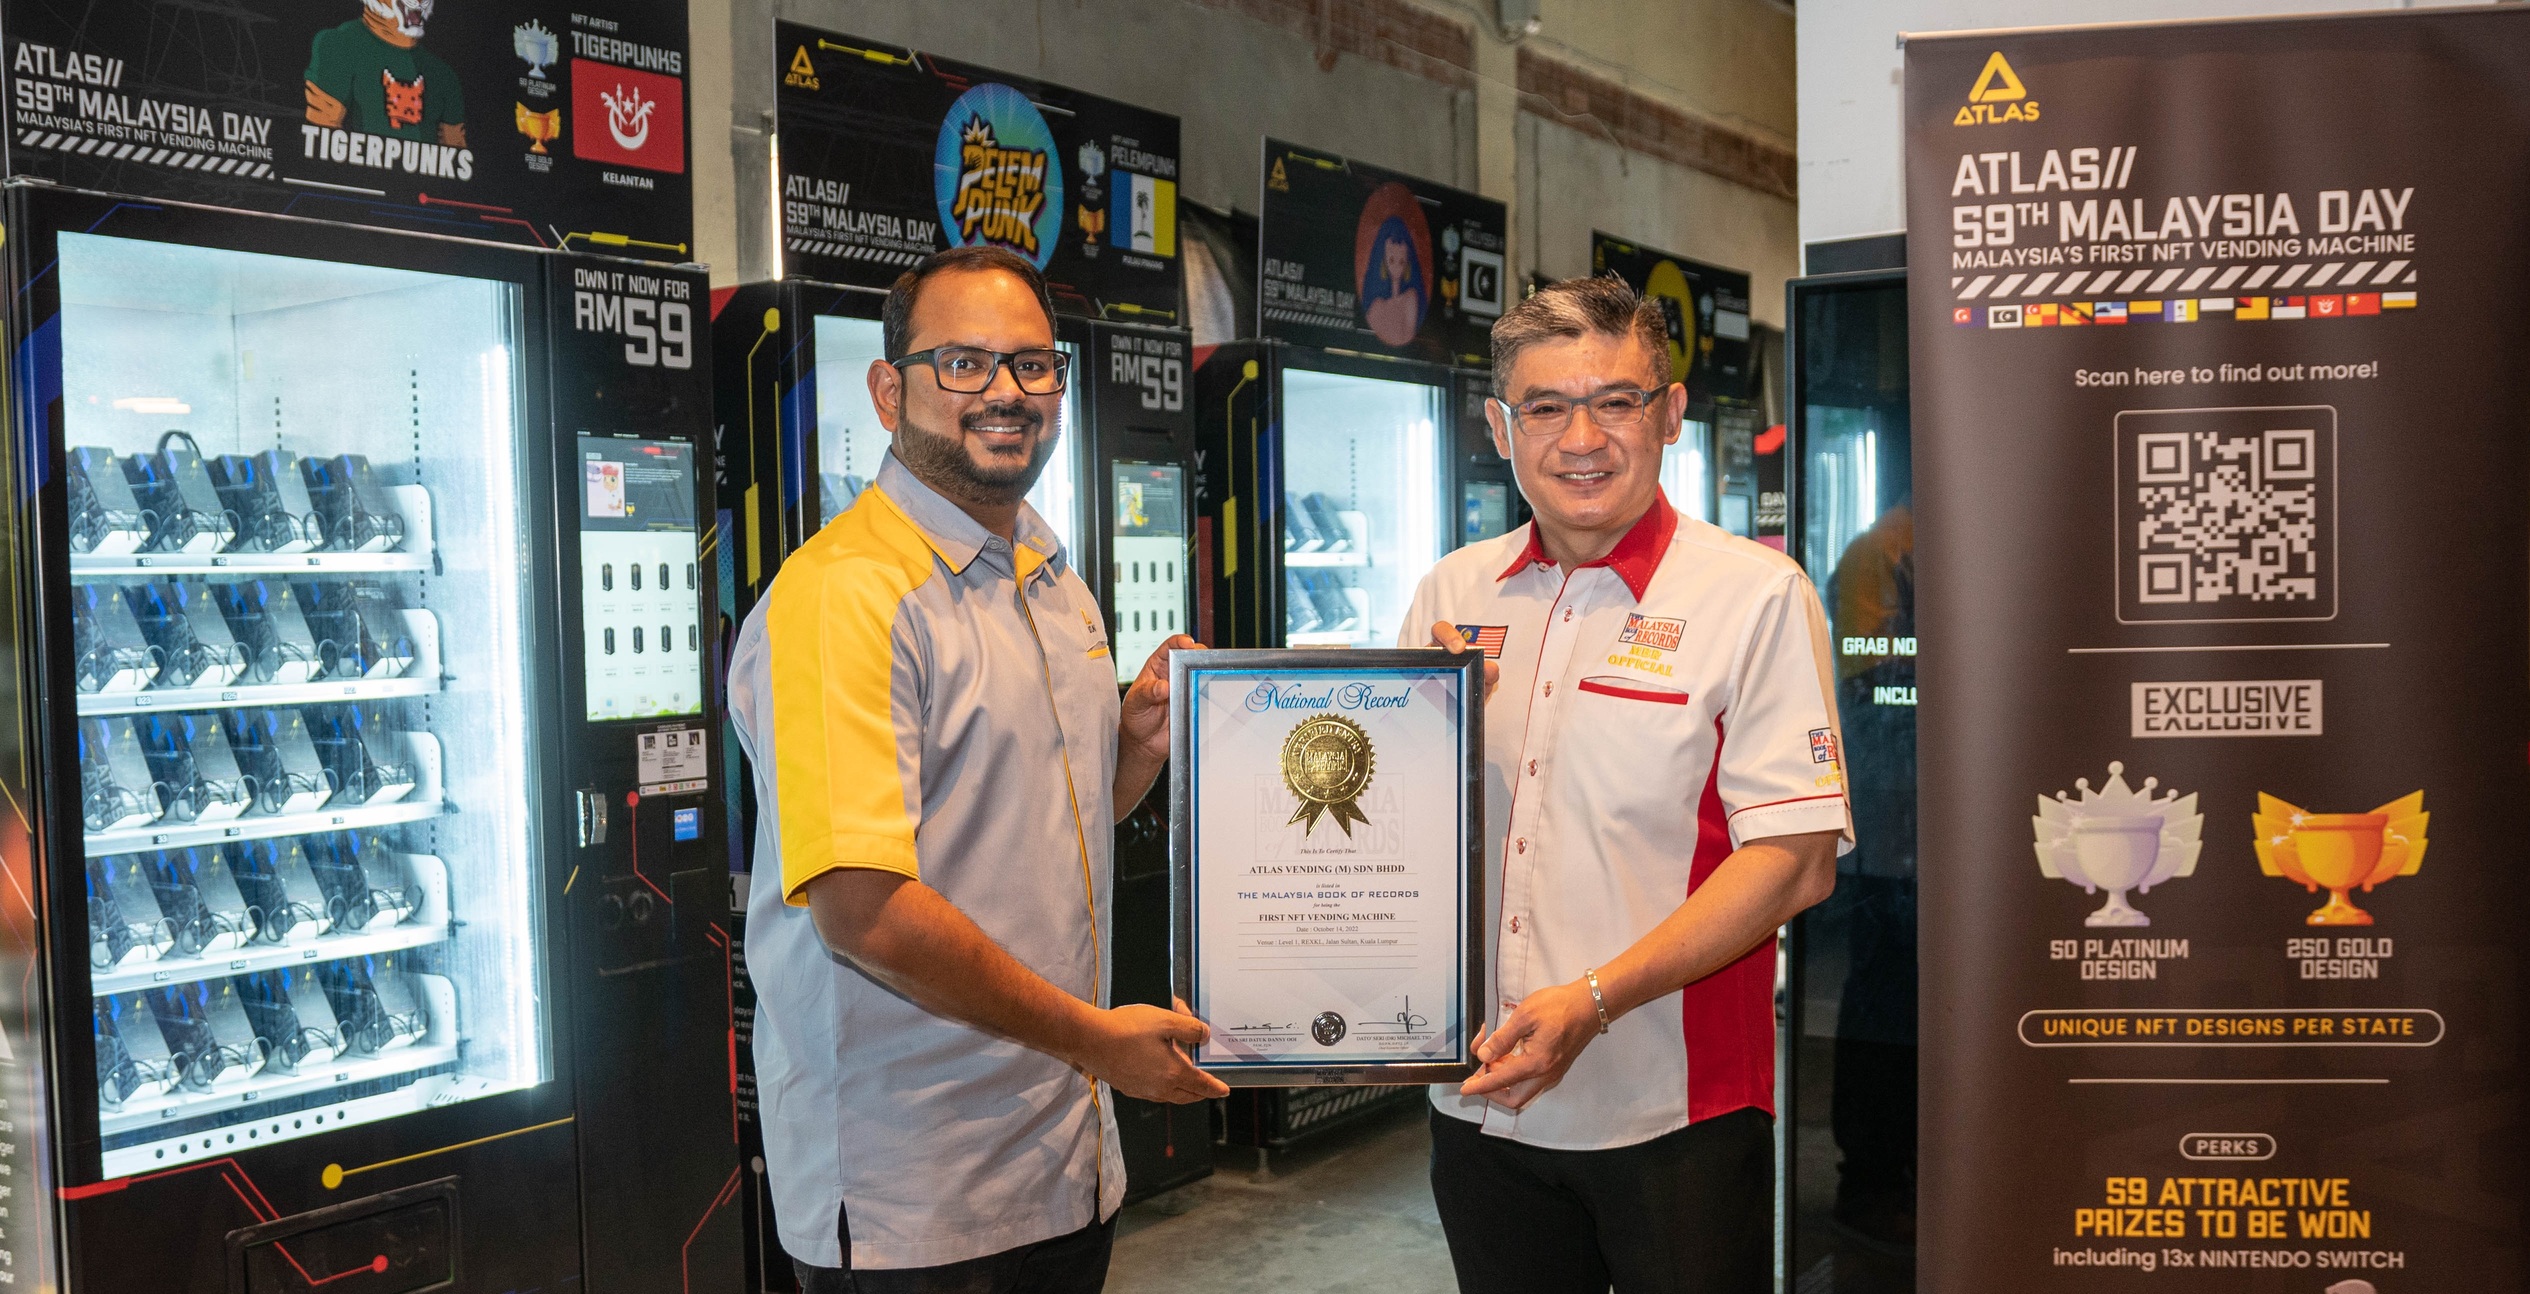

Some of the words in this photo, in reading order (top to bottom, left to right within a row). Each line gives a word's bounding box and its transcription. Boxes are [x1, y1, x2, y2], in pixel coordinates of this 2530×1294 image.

[571, 13, 588, 25] NFT
[589, 15, 619, 31] ARTIST
[571, 30, 682, 74] TIGERPUNKS
[14, 42, 124, 88] ATLAS//
[784, 72, 820, 91] ATLAS
[79, 88, 214, 138] MALAYSIA
[223, 111, 272, 145] DAY
[1953, 101, 2040, 126] ATLAS
[17, 110, 94, 133] MALAYSIA'S
[97, 123, 131, 140] FIRST
[134, 129, 157, 144] NFT
[160, 132, 215, 152] VENDING
[218, 142, 273, 161] MACHINE
[302, 124, 474, 182] TIGERPUNKS
[602, 171, 654, 190] KELANTAN
[1951, 146, 2138, 197] ATLAS//
[785, 174, 850, 205] ATLAS//
[822, 206, 903, 239] MALAYSIA
[906, 218, 937, 243] DAY
[962, 187, 1044, 253] PUNK
[2058, 193, 2300, 244] MALAYSIA
[2319, 188, 2415, 234] DAY
[787, 225, 832, 239] MALAYSIA'S
[833, 231, 853, 243] FIRST
[854, 234, 869, 245] NFT
[870, 235, 903, 248] VENDING
[1952, 245, 2083, 270] MALAYSIA'S
[2089, 243, 2146, 265] FIRST
[2152, 241, 2195, 262] NFT
[2201, 238, 2302, 260] VENDING
[2307, 234, 2415, 257] MACHINE
[575, 268, 608, 291] OWN
[612, 272, 624, 292] IT
[629, 274, 660, 297] NOW
[664, 279, 690, 300] FOR
[2074, 368, 2129, 387] Scan
[2134, 366, 2185, 386] here
[2190, 366, 2215, 384] to
[2219, 363, 2262, 383] find
[2266, 364, 2304, 382] out
[2309, 361, 2379, 381] more!
[1628, 618, 1680, 635] MALAYSIA
[1634, 630, 1680, 649] RECORDS
[1842, 637, 1889, 656] GRAB
[1607, 654, 1673, 677] OFFICIAL
[1245, 682, 1334, 713] National
[1337, 682, 1412, 711] Record
[2145, 685, 2312, 715] EXCLUSIVE
[1249, 865, 1283, 874] ATLAS
[1285, 865, 1333, 874] VENDING
[1335, 864, 1351, 875] (M)
[1353, 864, 1374, 873] SDN
[1376, 864, 1405, 873] BHDD
[1262, 891, 1314, 899] MALAYSIA
[1317, 891, 1347, 899] BOOK
[1350, 891, 1365, 899] OF
[1369, 890, 1419, 898] RECORDS
[1259, 914, 1286, 922] FIRST
[1287, 913, 1306, 921] NFT
[1307, 913, 1350, 921] VENDING
[1351, 912, 1396, 921] MACHINE
[1377, 938, 1398, 946] Lumpur
[2049, 939, 2078, 960] 50
[2084, 938, 2189, 960] PLATINUM
[2286, 938, 2331, 959] 250
[2337, 937, 2393, 958] GOLD
[2080, 960, 2157, 981] DESIGN
[2300, 958, 2379, 980] DESIGN
[2043, 1018, 2127, 1039] UNIQUE
[2136, 1018, 2177, 1036] NFT
[2185, 1018, 2285, 1036] DESIGNS
[2293, 1018, 2335, 1035] PER
[2342, 1017, 2415, 1036] STATE
[2196, 1139, 2260, 1155] PERKS
[2105, 1177, 2149, 1206] 59
[2158, 1177, 2351, 1207] ATTRACTIVE
[2075, 1208, 2186, 1238] PRIZES
[2195, 1209, 2238, 1239] TO
[2247, 1209, 2288, 1239] BE
[2298, 1210, 2372, 1239] WON
[2053, 1247, 2157, 1272] including
[2161, 1249, 2195, 1268] 13x
[2200, 1249, 2311, 1269] NINTENDO
[2316, 1251, 2405, 1270] SWITCH
